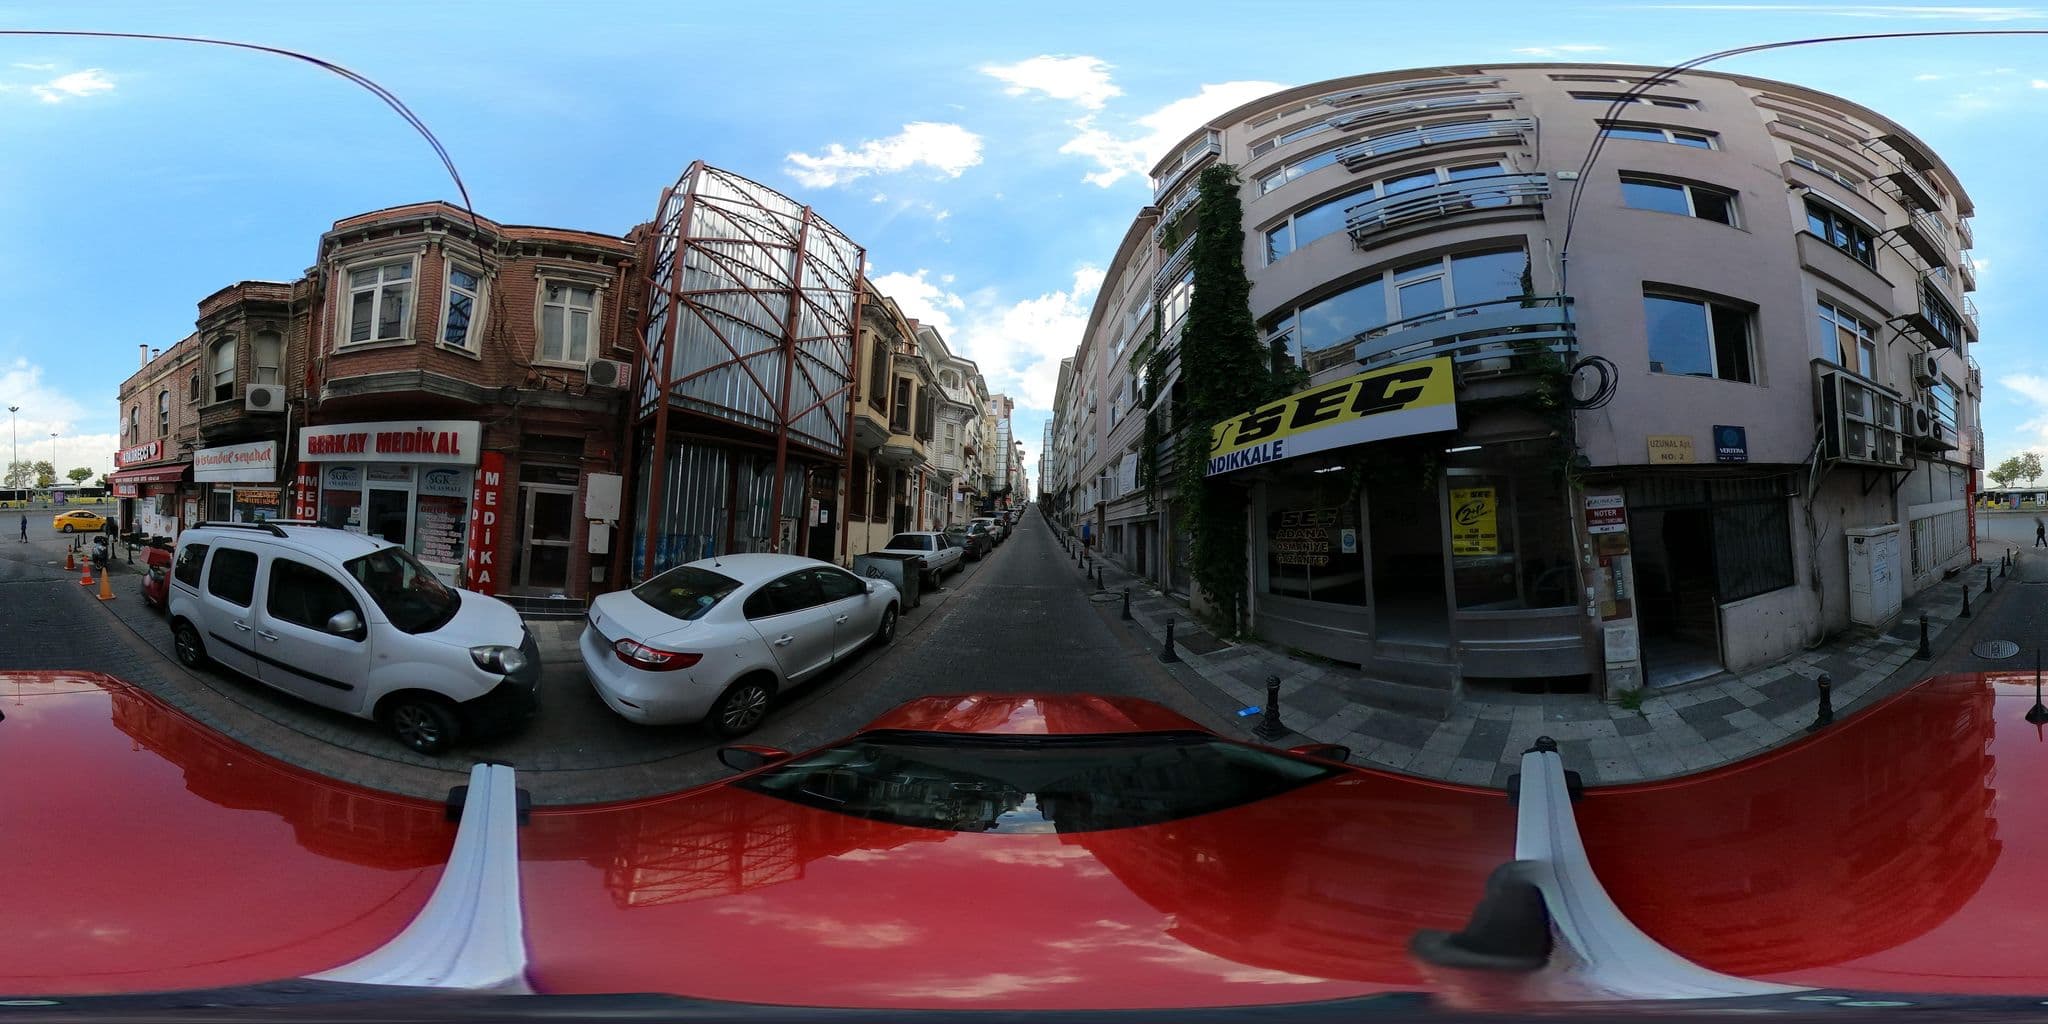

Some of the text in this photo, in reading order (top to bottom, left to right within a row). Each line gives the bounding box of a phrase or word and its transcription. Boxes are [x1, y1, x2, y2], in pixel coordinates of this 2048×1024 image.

[308, 426, 461, 456] BERKAY MEDİKAL
[1594, 510, 1617, 518] NOTER
[467, 468, 482, 591] MEDİKA
[478, 471, 500, 594] MEDİKA
[1276, 528, 1329, 540] ADANA
